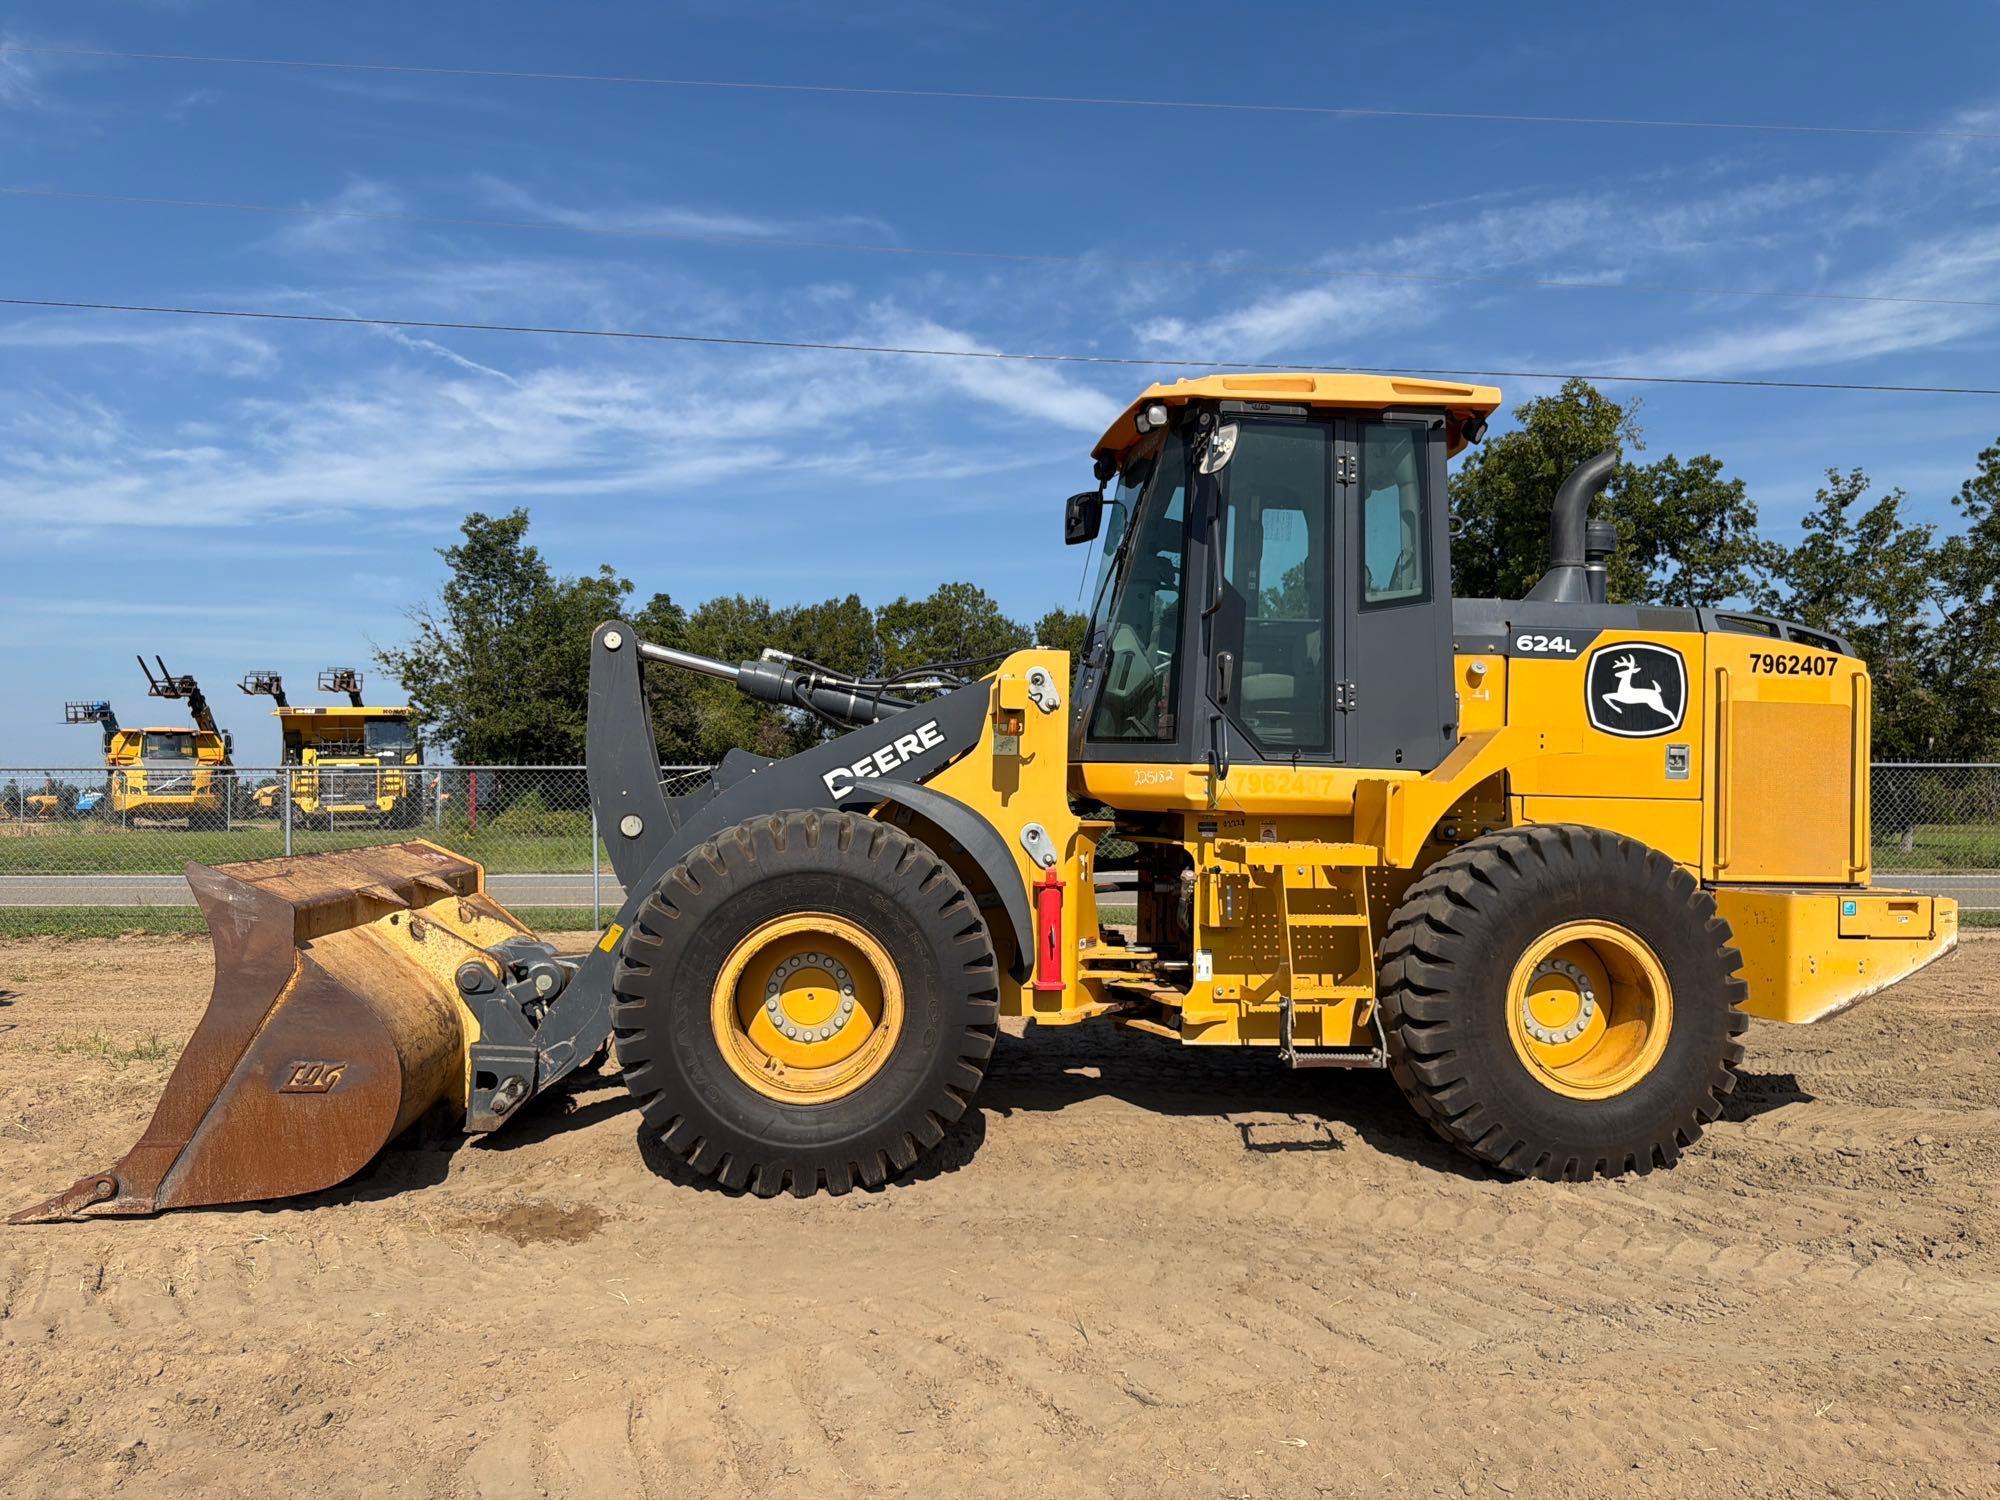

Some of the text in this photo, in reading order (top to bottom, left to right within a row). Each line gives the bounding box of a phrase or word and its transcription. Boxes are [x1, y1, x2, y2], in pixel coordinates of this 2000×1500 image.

[1516, 634, 1577, 653] 624L
[1749, 653, 1839, 676] 7962407
[822, 720, 946, 800] DEERE
[1134, 768, 1175, 786] 225182
[1233, 771, 1335, 796] 7962407
